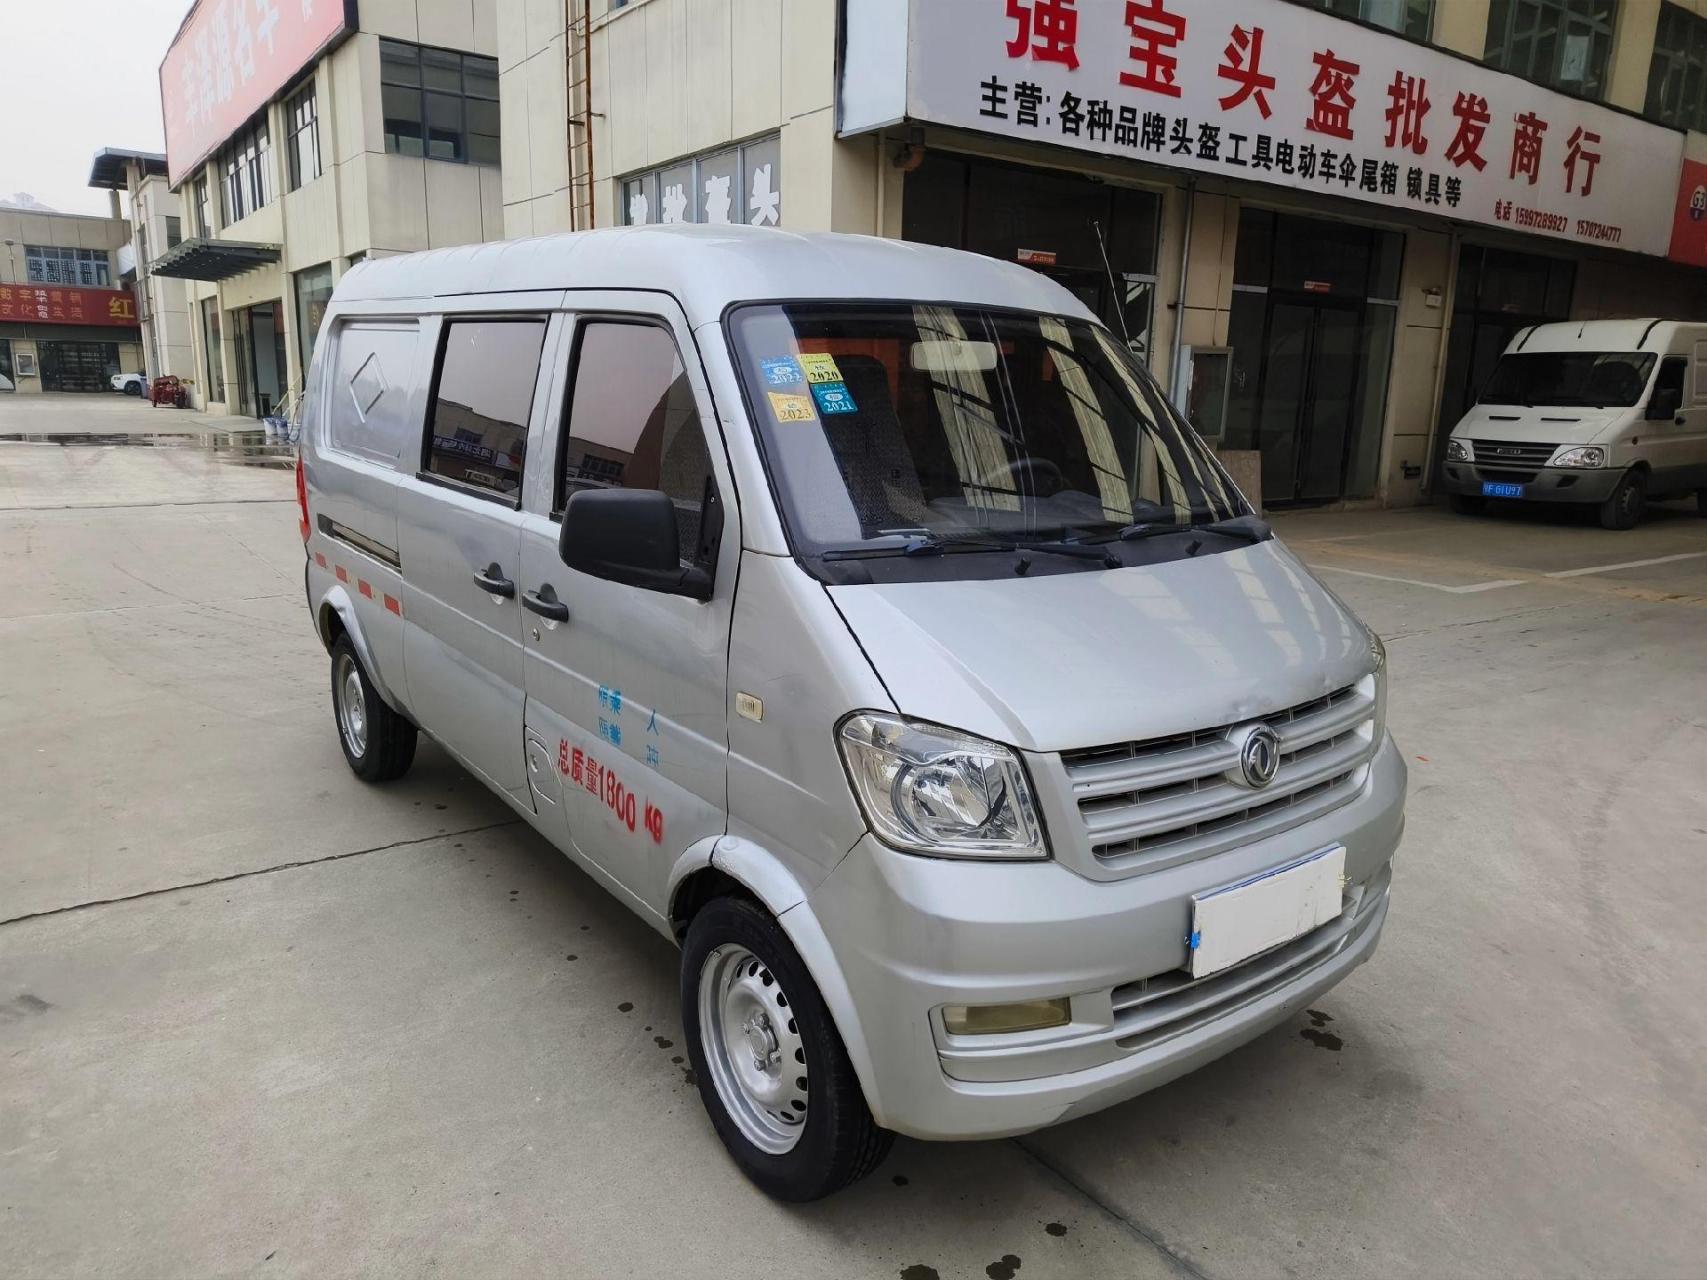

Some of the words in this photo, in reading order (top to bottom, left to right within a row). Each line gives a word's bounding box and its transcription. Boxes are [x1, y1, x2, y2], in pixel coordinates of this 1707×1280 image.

[1494, 198, 1513, 222] 电话
[109, 296, 135, 318] 红
[809, 370, 840, 381] 2020
[823, 400, 854, 412] 2021
[780, 408, 812, 420] 2023
